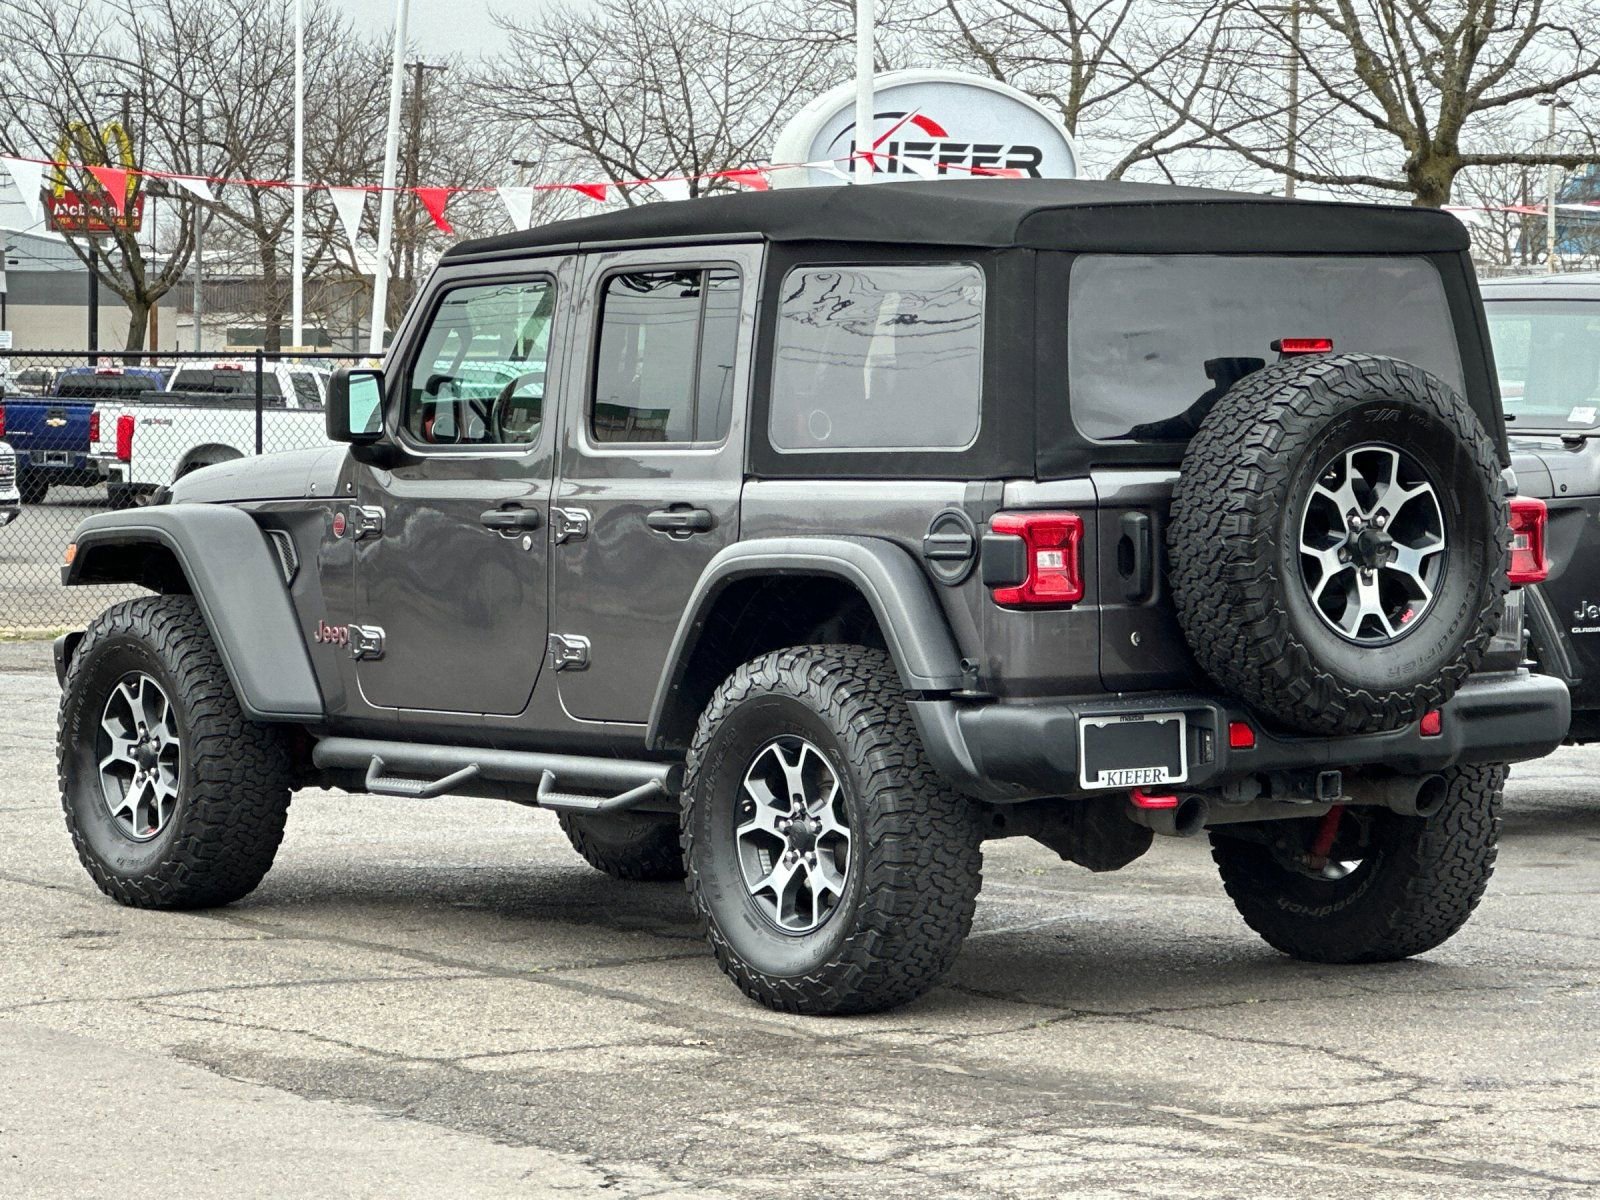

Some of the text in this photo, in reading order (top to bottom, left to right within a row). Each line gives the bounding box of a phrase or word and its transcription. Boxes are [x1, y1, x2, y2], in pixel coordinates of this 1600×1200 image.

[1574, 600, 1600, 620] Je
[314, 620, 348, 648] Jeep
[1106, 769, 1162, 786] KIEFER
